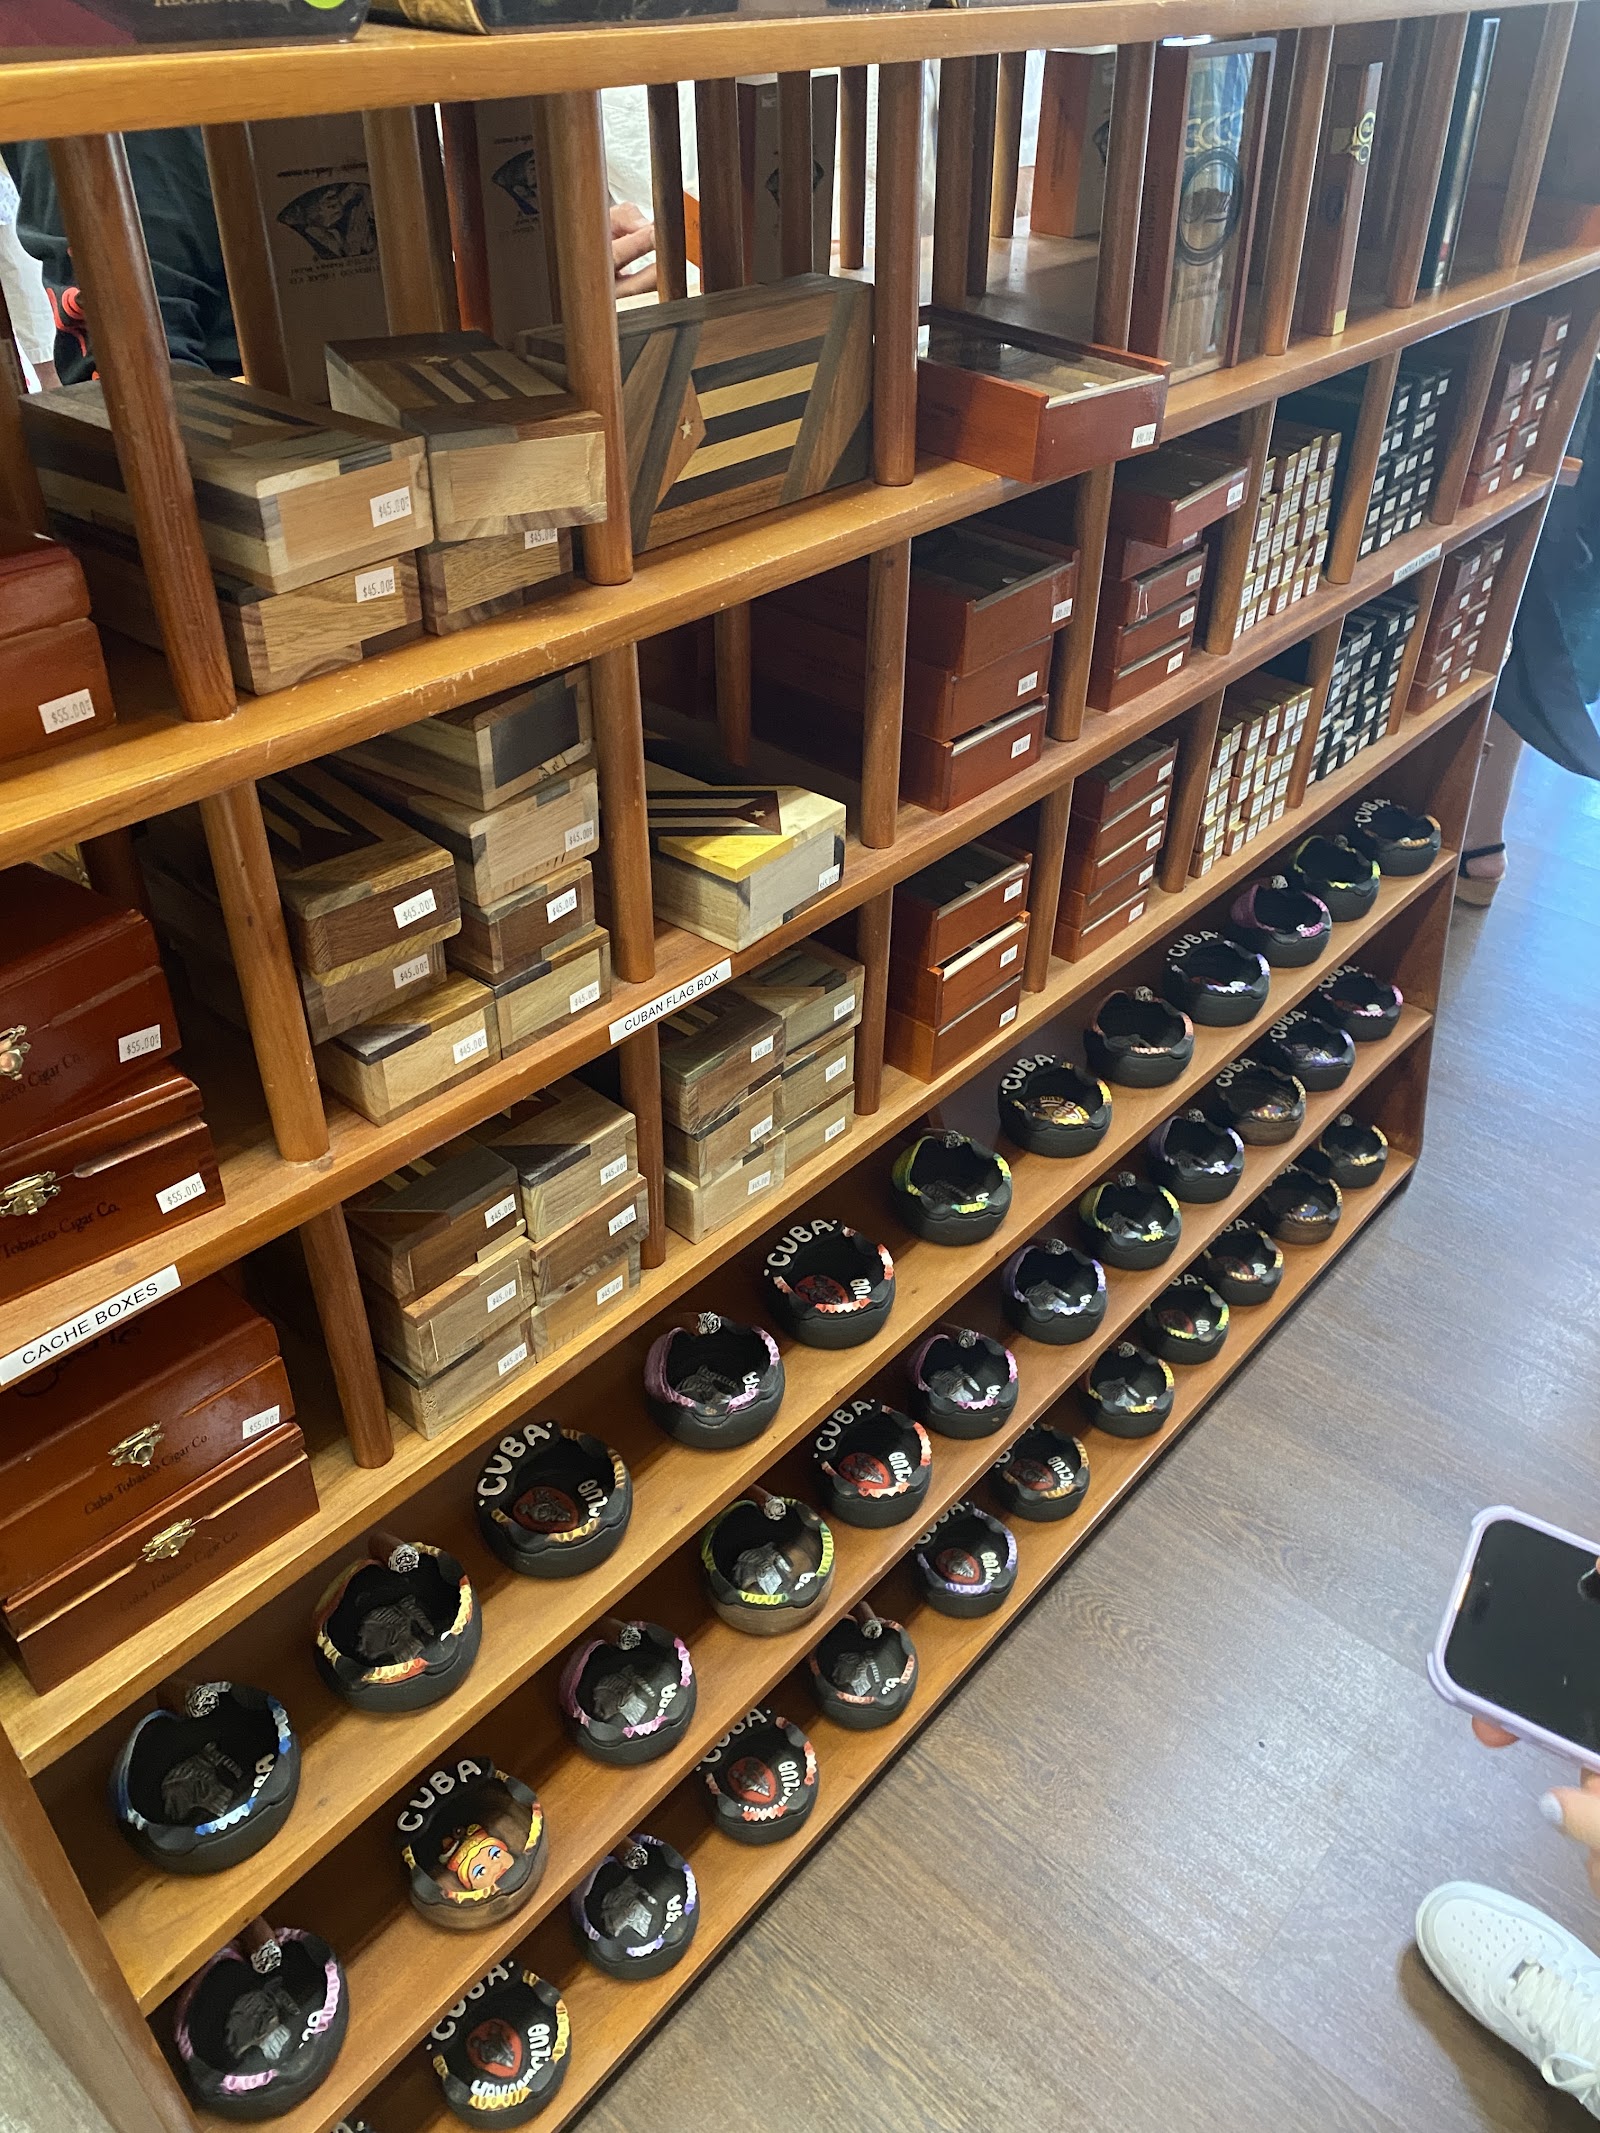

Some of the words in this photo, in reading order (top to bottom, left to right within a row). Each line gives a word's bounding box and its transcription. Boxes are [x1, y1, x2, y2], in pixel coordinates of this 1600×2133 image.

[1169, 931, 1217, 957] CUBA
[624, 1001, 664, 1031] CUBAN
[666, 985, 695, 1009] FLAG
[697, 970, 720, 991] BOX
[1001, 1054, 1053, 1089] CUBA
[1216, 1058, 1257, 1087] CUBA
[168, 1181, 204, 1206] $55.00
[767, 1219, 834, 1267] CUBA
[22, 1319, 91, 1365] CACHE
[95, 1282, 158, 1325] BOXES
[816, 1400, 872, 1451] CUBA
[477, 1423, 551, 1496] CUBA
[397, 1759, 482, 1831] CUBA
